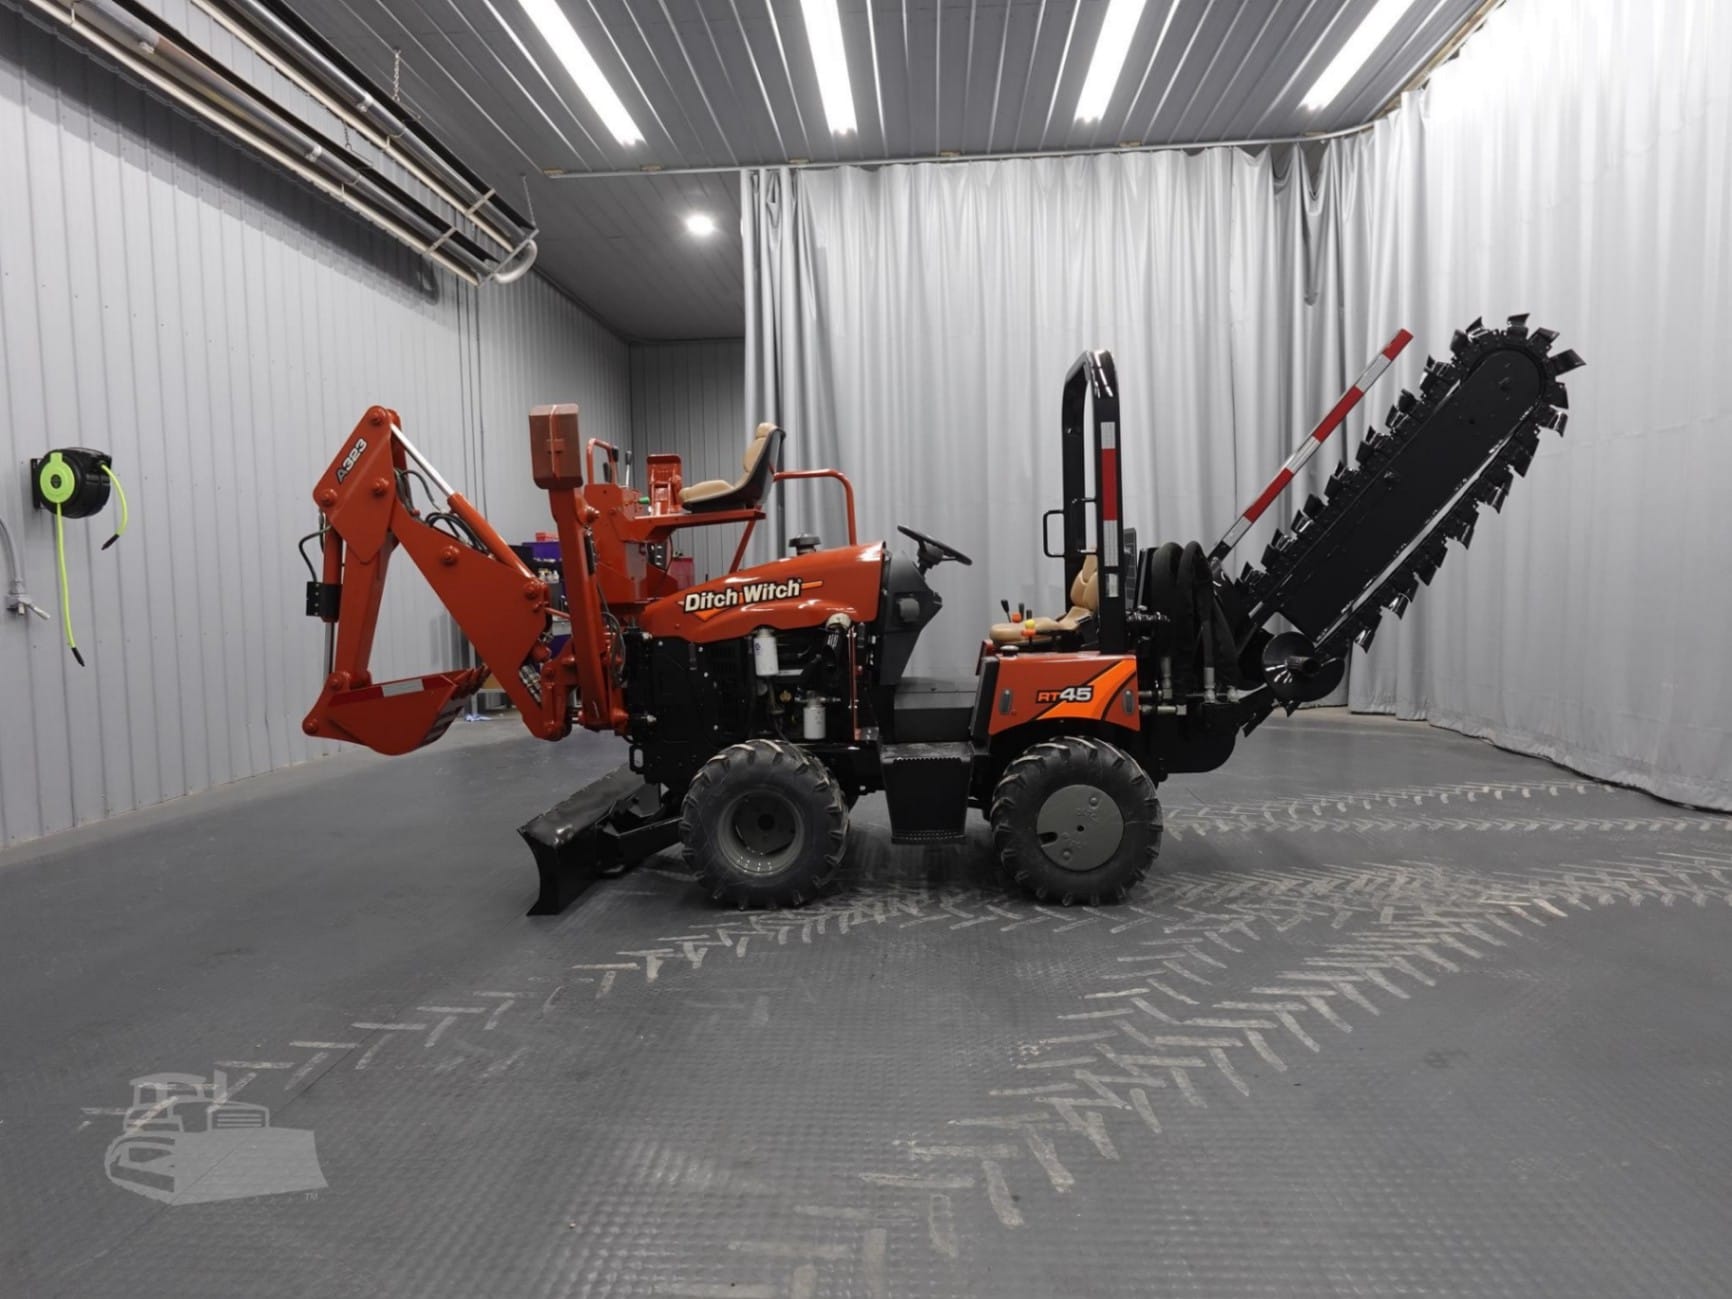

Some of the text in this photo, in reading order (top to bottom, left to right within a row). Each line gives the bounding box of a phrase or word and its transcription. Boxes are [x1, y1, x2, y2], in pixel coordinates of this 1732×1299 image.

[337, 437, 368, 483] A323
[684, 578, 801, 612] Ditch Witch
